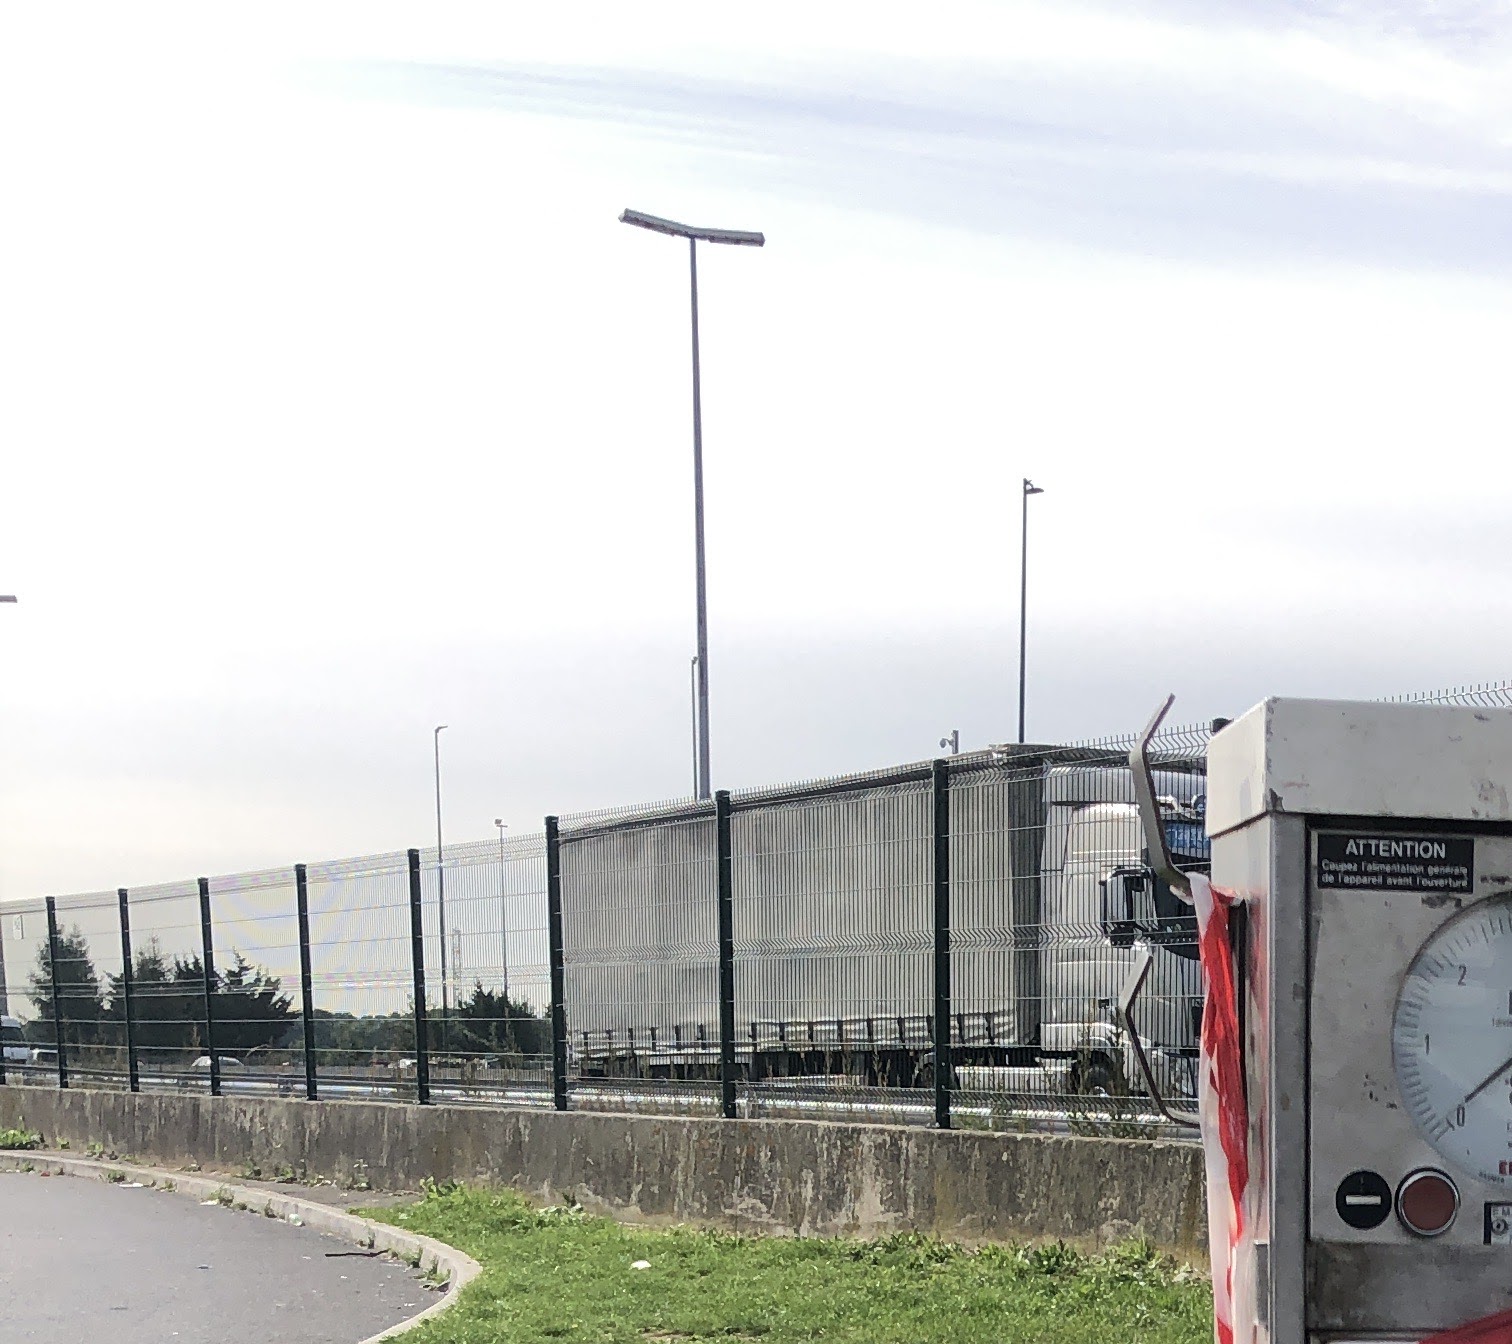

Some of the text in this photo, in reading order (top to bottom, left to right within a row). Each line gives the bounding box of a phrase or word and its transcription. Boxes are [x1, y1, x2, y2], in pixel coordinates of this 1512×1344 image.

[1346, 838, 1446, 858] ATTENTION
[1458, 965, 1467, 986] 2
[1424, 1035, 1430, 1056] 1
[1456, 1107, 1465, 1128] 0
